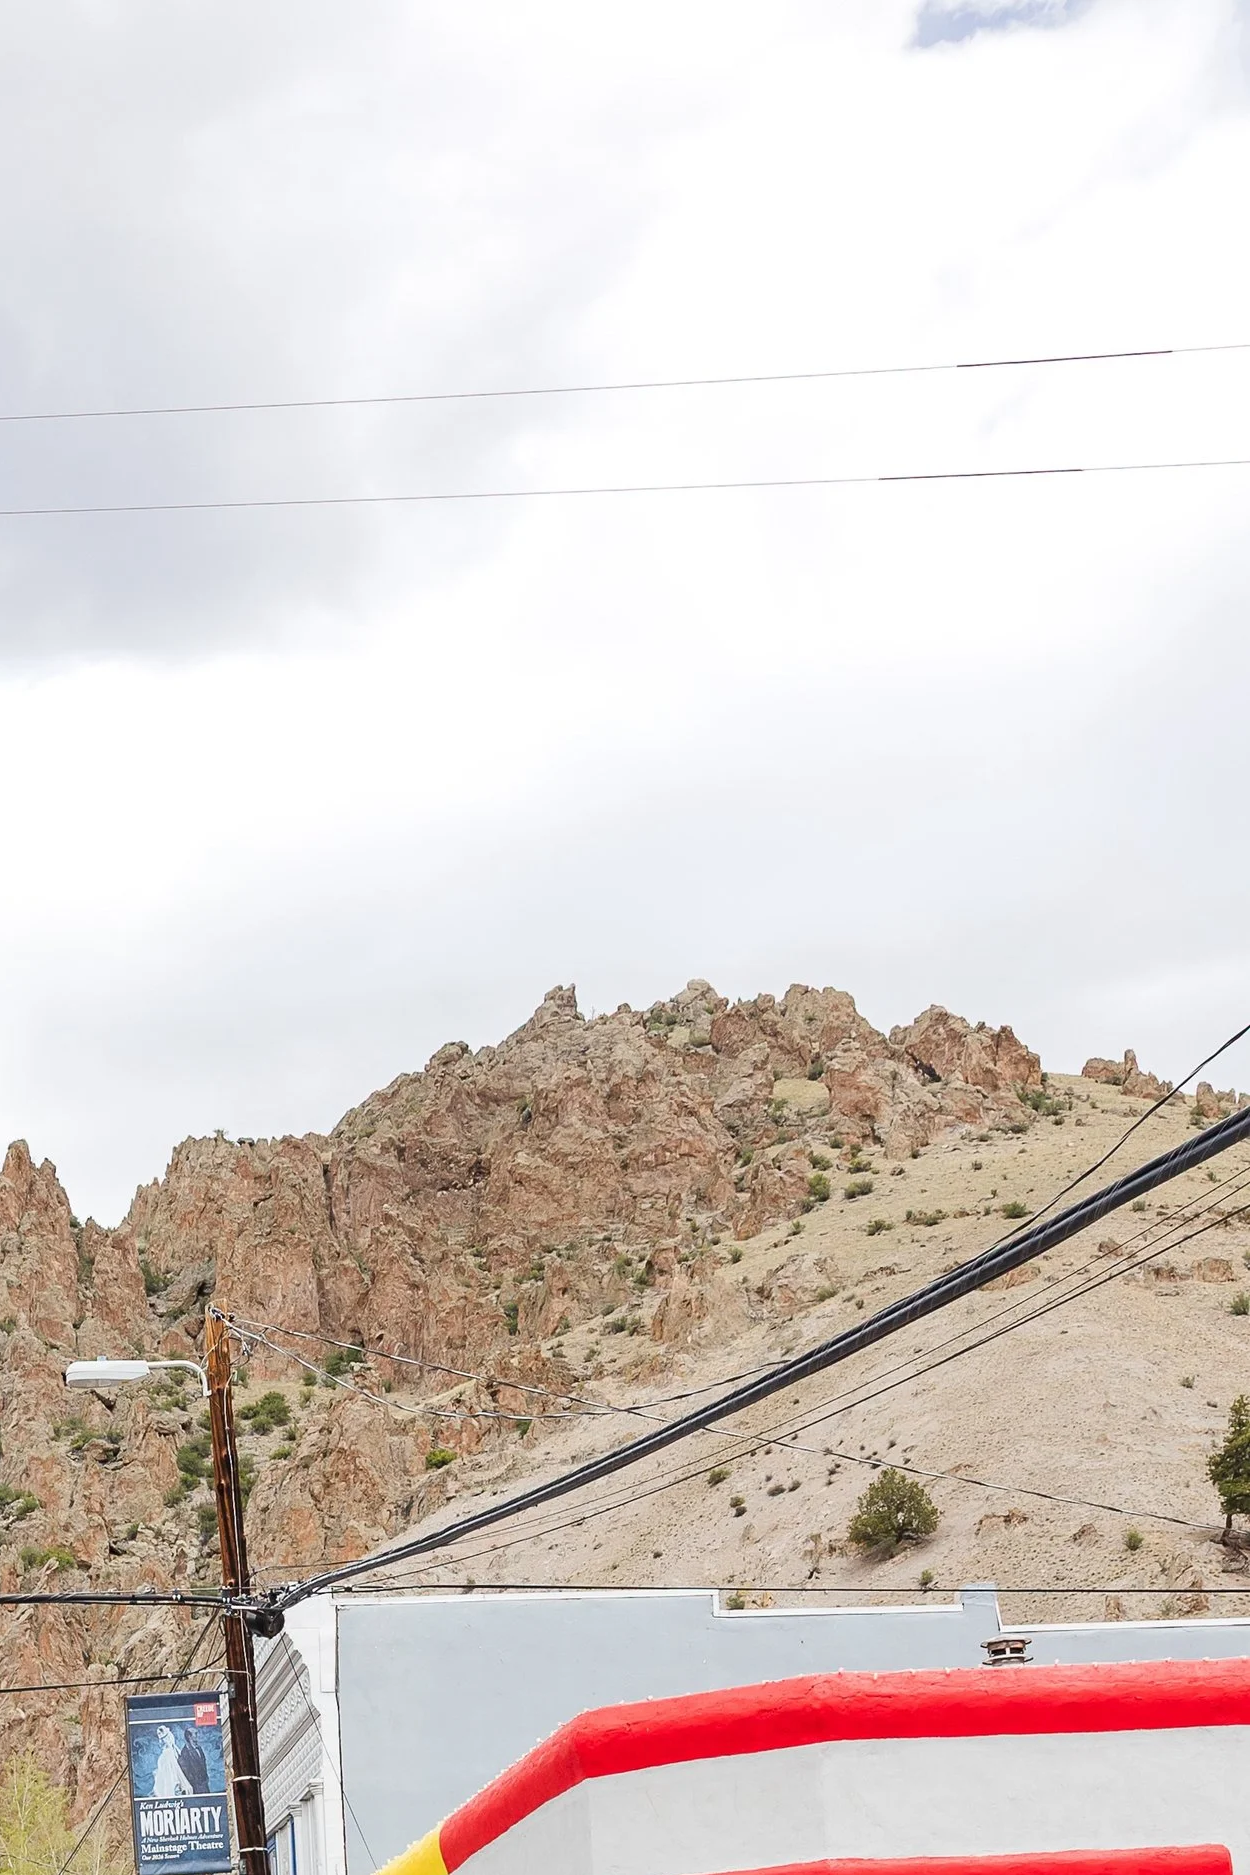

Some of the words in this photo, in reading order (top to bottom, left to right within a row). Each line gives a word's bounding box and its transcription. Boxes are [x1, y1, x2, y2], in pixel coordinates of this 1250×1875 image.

[140, 1802, 153, 1810] Ken
[154, 1800, 184, 1809] Ludwig's
[139, 1806, 222, 1837] MORIARTY
[141, 1843, 188, 1854] Mainstage
[188, 1840, 224, 1851] Theatre
